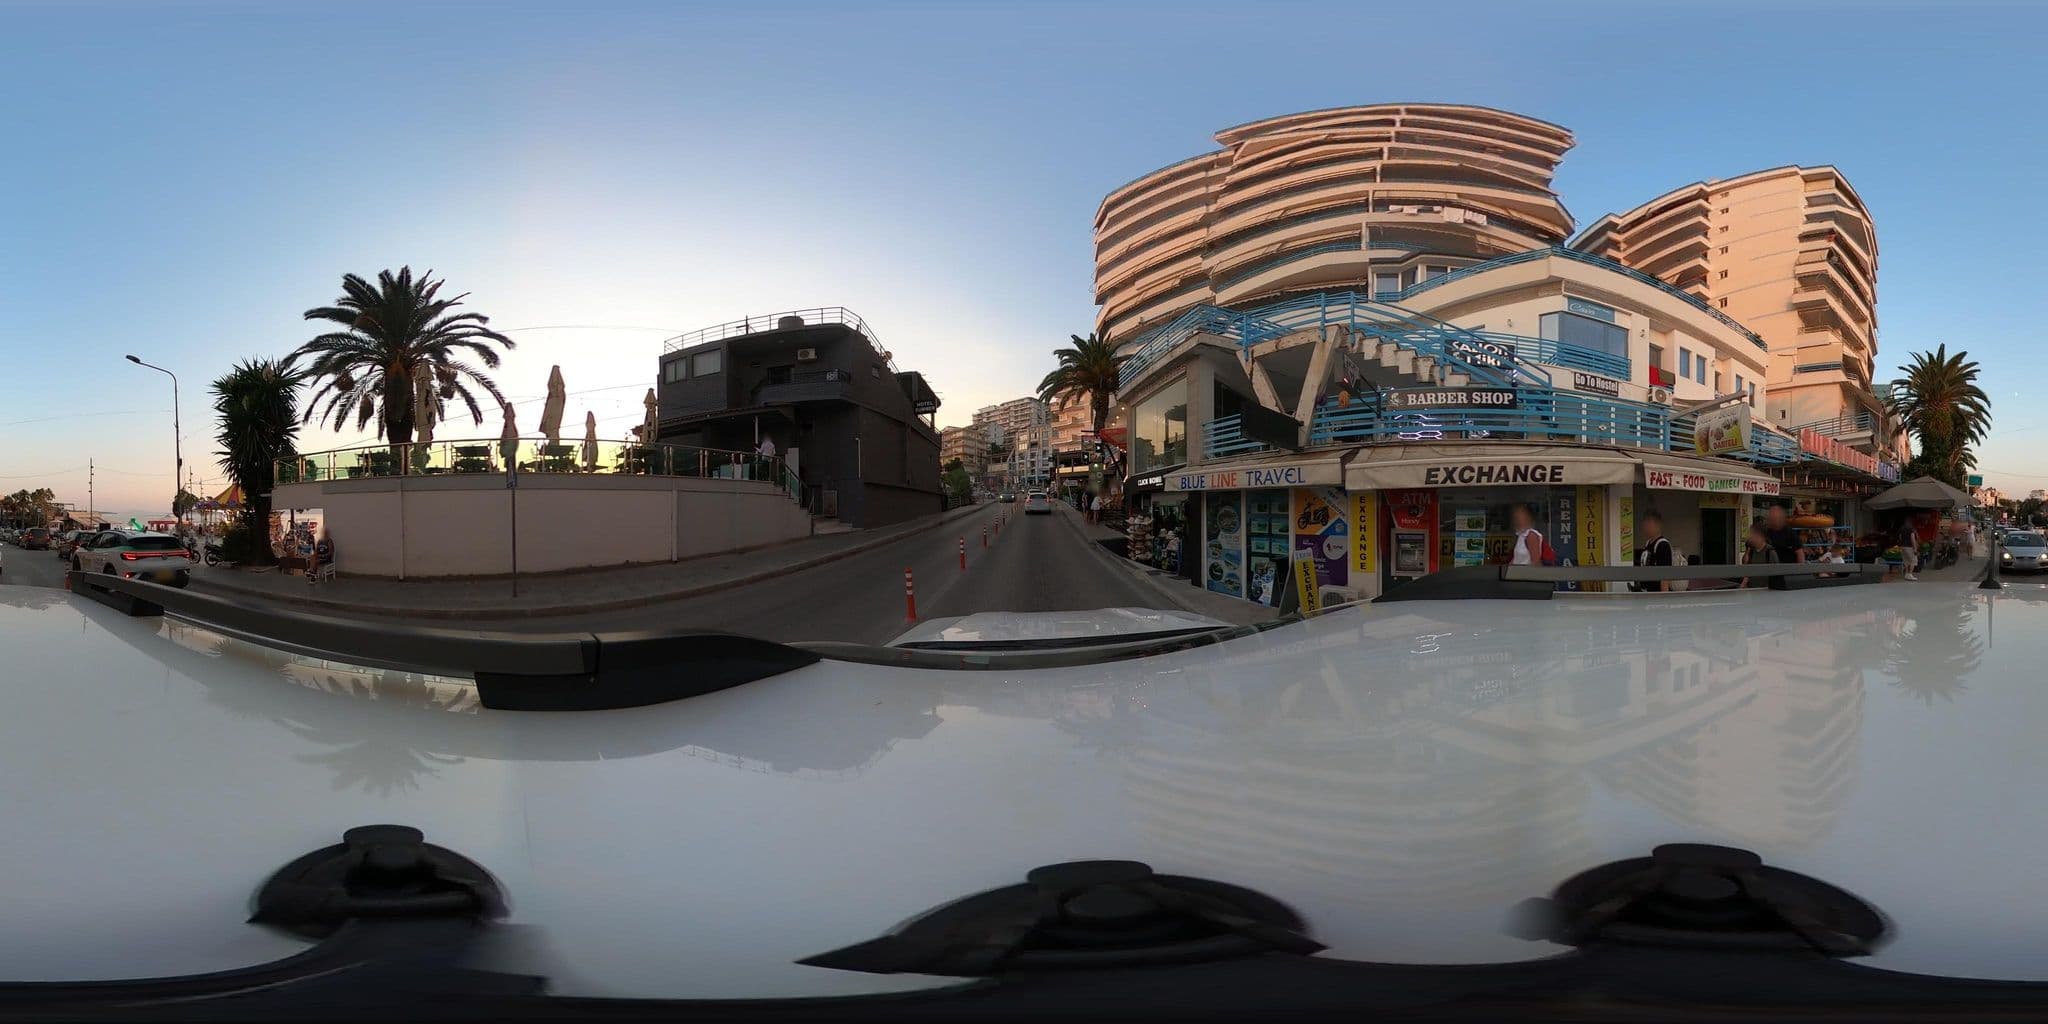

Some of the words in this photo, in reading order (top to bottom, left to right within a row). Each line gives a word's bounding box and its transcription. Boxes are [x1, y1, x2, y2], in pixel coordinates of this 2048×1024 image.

[1575, 373, 1586, 385] Go
[1586, 375, 1596, 387] To
[1596, 376, 1618, 392] Hostel
[1407, 391, 1469, 406] BARBER
[1472, 391, 1514, 405] SHOP
[1180, 474, 1205, 490] BLUE
[1211, 472, 1237, 488] LINE
[1246, 467, 1306, 486] TRAVEL
[1425, 465, 1564, 485] EXCHANGE
[1650, 472, 1673, 487] FAST
[1683, 474, 1705, 489] FOOD
[1743, 480, 1758, 492] FAST
[1764, 482, 1778, 494] FOOD
[1400, 492, 1431, 505] ATM
[1560, 498, 1572, 544] RENT
[1359, 496, 1367, 570] EXCHANGE
